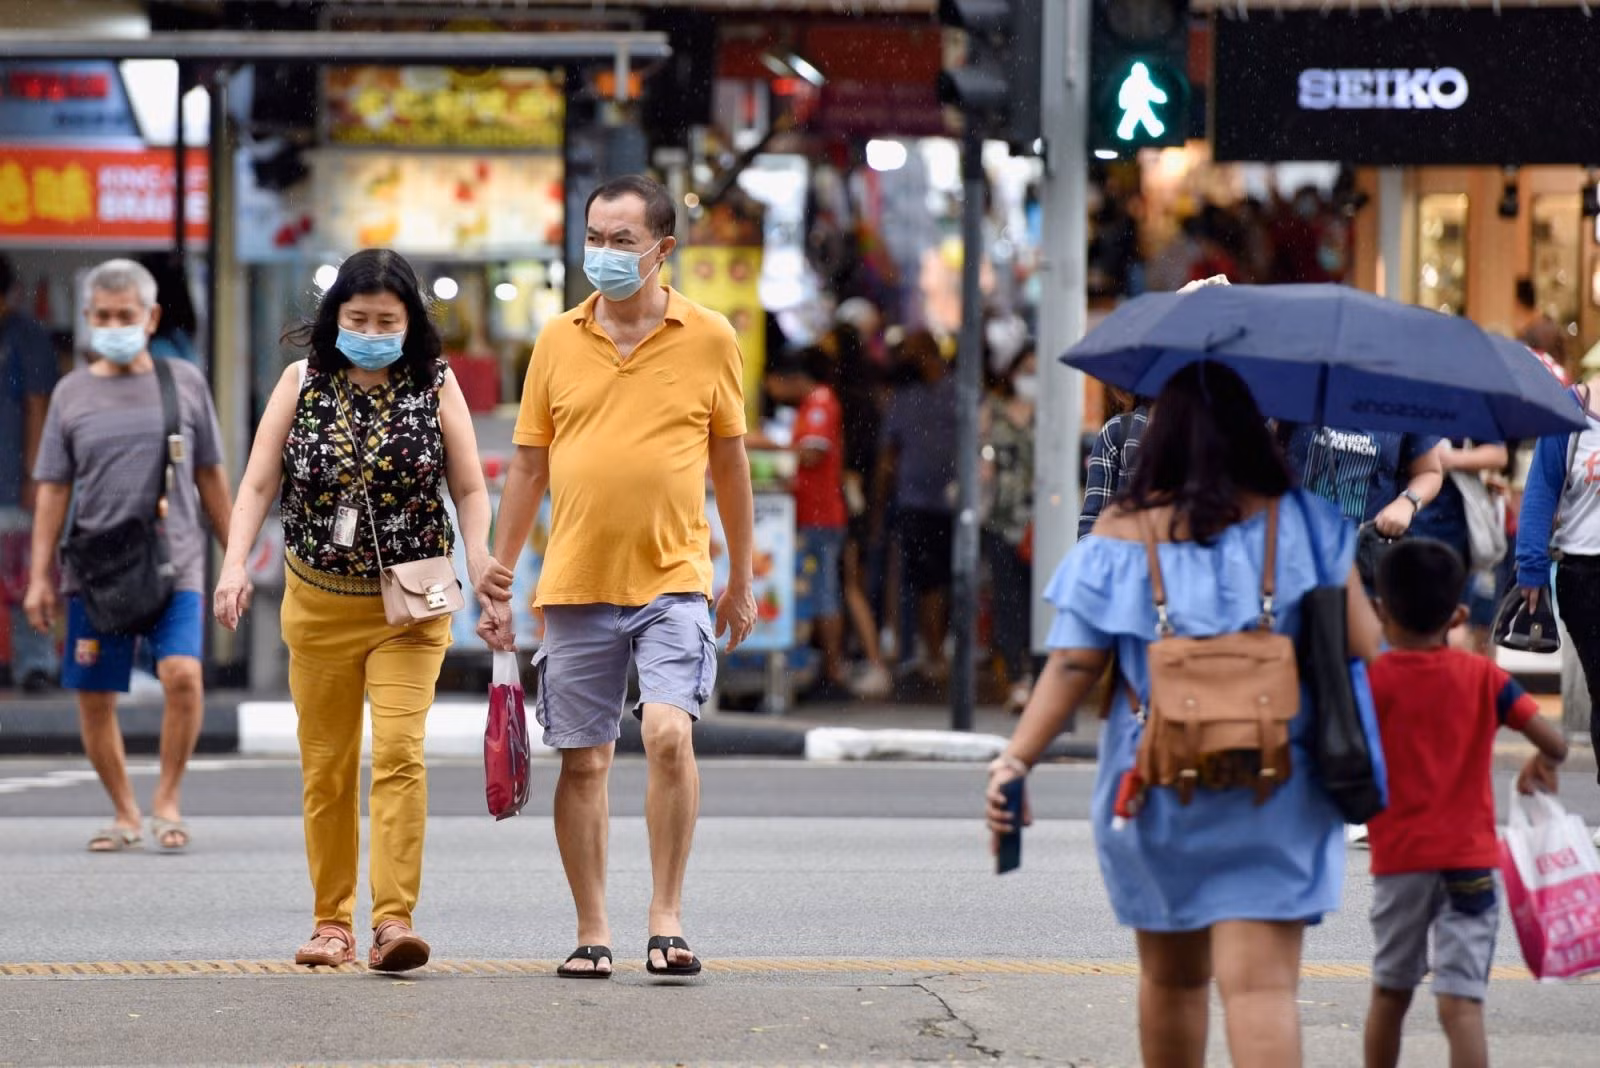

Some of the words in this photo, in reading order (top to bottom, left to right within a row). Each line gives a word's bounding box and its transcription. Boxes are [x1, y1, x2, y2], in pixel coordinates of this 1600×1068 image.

[1298, 66, 1469, 110] SEIKO
[99, 189, 208, 223] BRAIE
[1314, 434, 1377, 456] MRATHON
